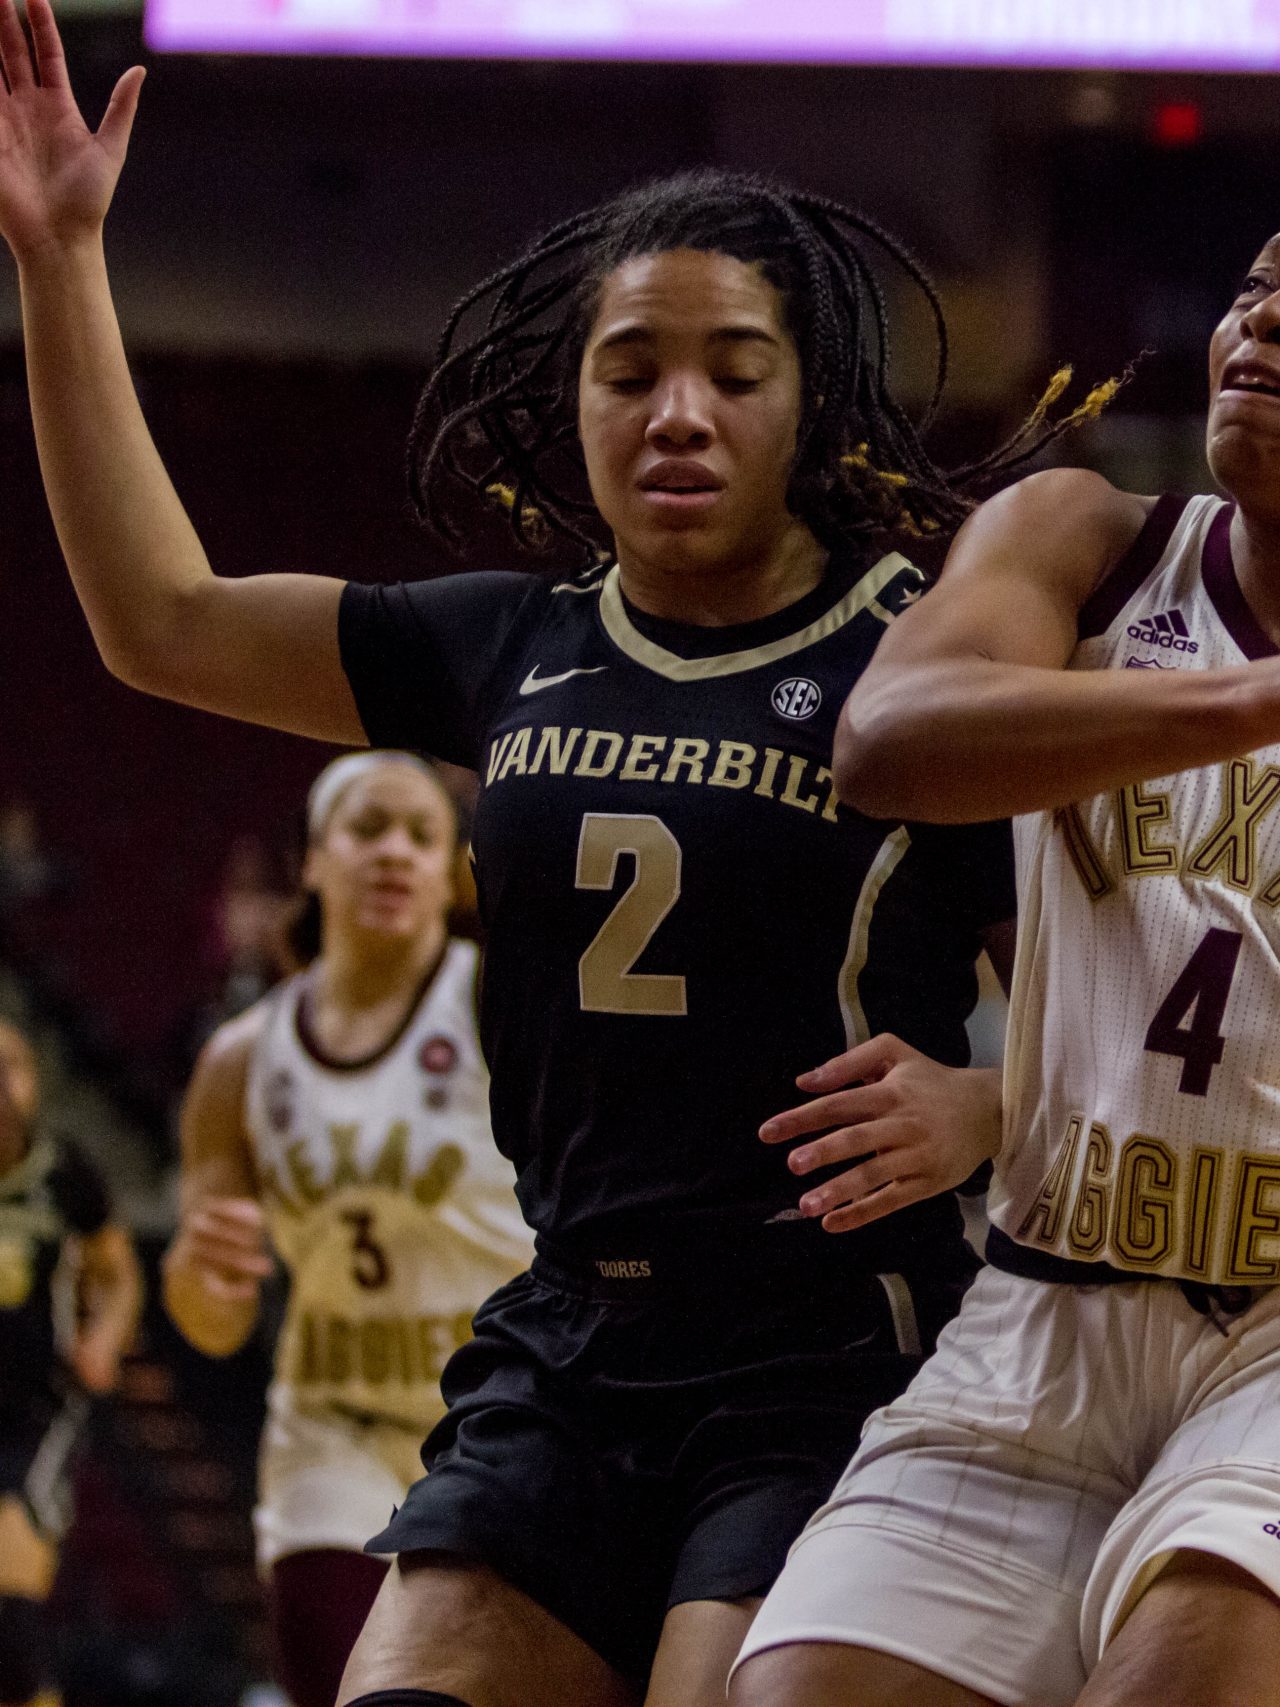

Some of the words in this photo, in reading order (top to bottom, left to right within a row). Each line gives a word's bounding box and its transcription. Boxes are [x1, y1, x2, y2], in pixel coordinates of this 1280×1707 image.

[1127, 624, 1199, 654] adidas
[775, 680, 818, 717] SEC
[575, 812, 688, 1015] 2
[1143, 926, 1243, 1096] 4
[342, 1206, 391, 1292] 3
